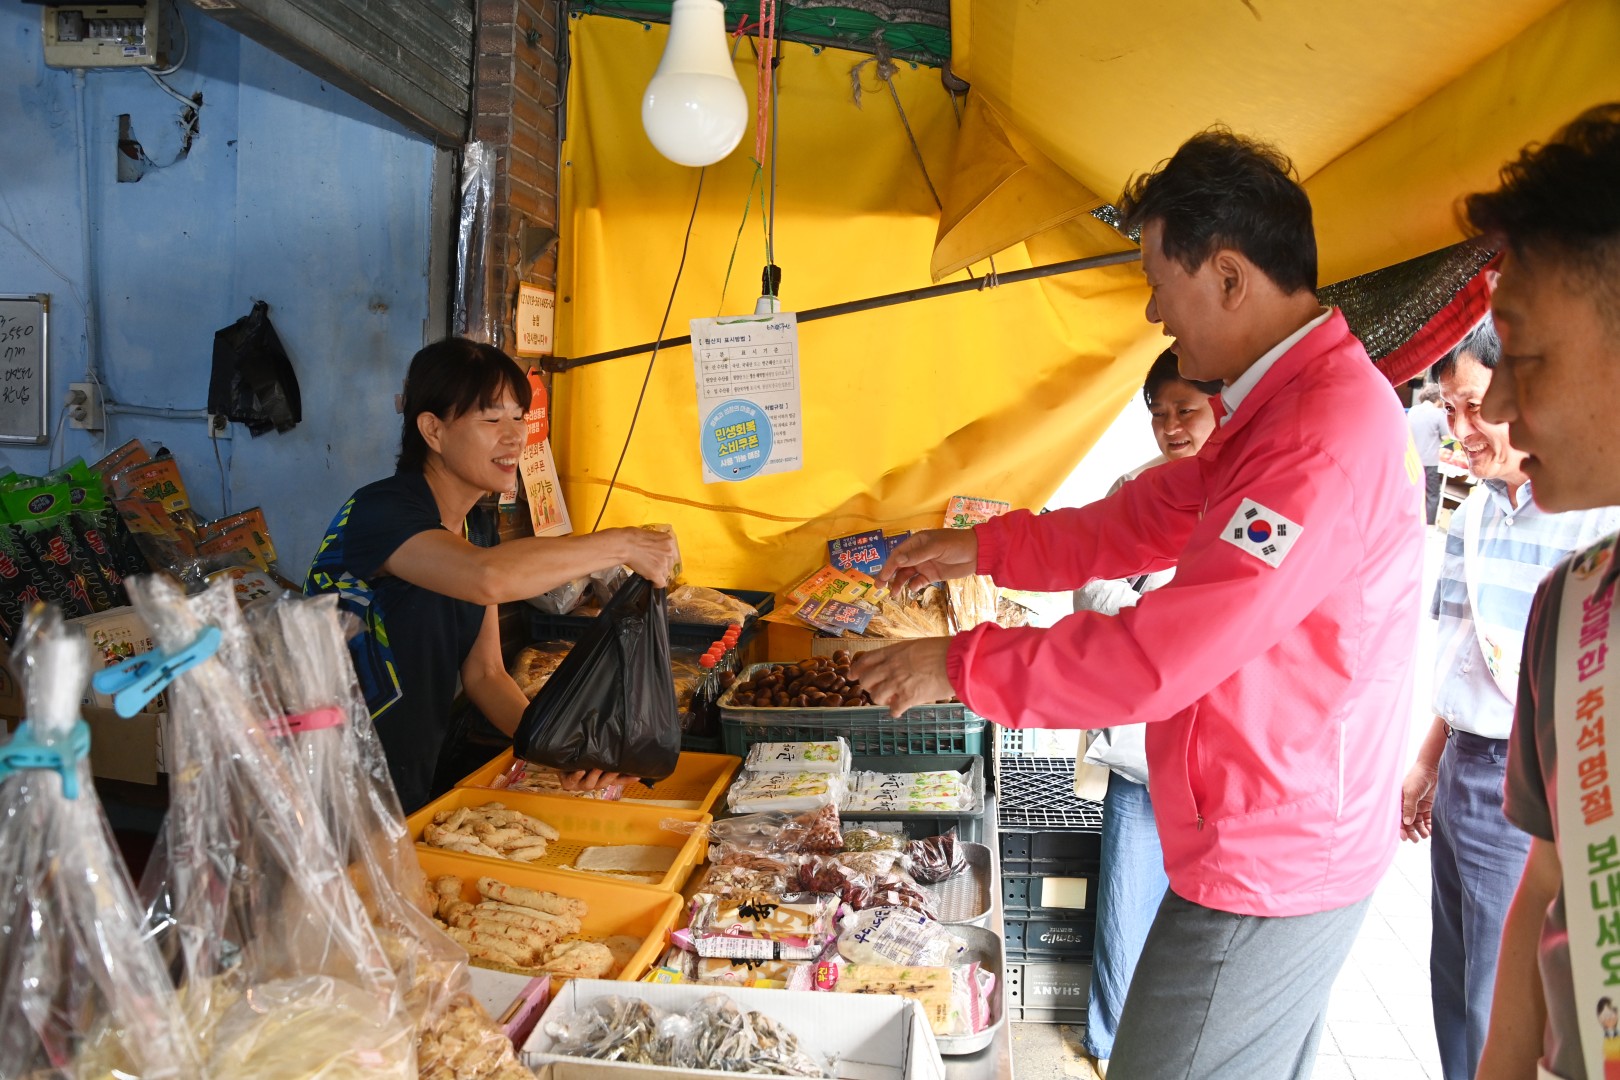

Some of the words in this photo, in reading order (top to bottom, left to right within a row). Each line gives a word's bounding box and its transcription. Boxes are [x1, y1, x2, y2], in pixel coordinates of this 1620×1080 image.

[526, 332, 545, 345] 감사합니다
[724, 335, 746, 343] 표시방법
[714, 419, 758, 443] 민생회복
[718, 434, 760, 457] 소비쿠폰
[720, 457, 734, 467] 사용
[734, 454, 747, 463] 가능
[747, 449, 761, 459] 매장
[526, 460, 546, 476] 소비쿠폰
[838, 548, 880, 570] 황태포
[776, 743, 796, 763] 곤약
[1575, 685, 1615, 826] 추석명절
[1040, 932, 1083, 944] samlip
[817, 966, 829, 983] 부산
[1033, 987, 1081, 996] SHANY
